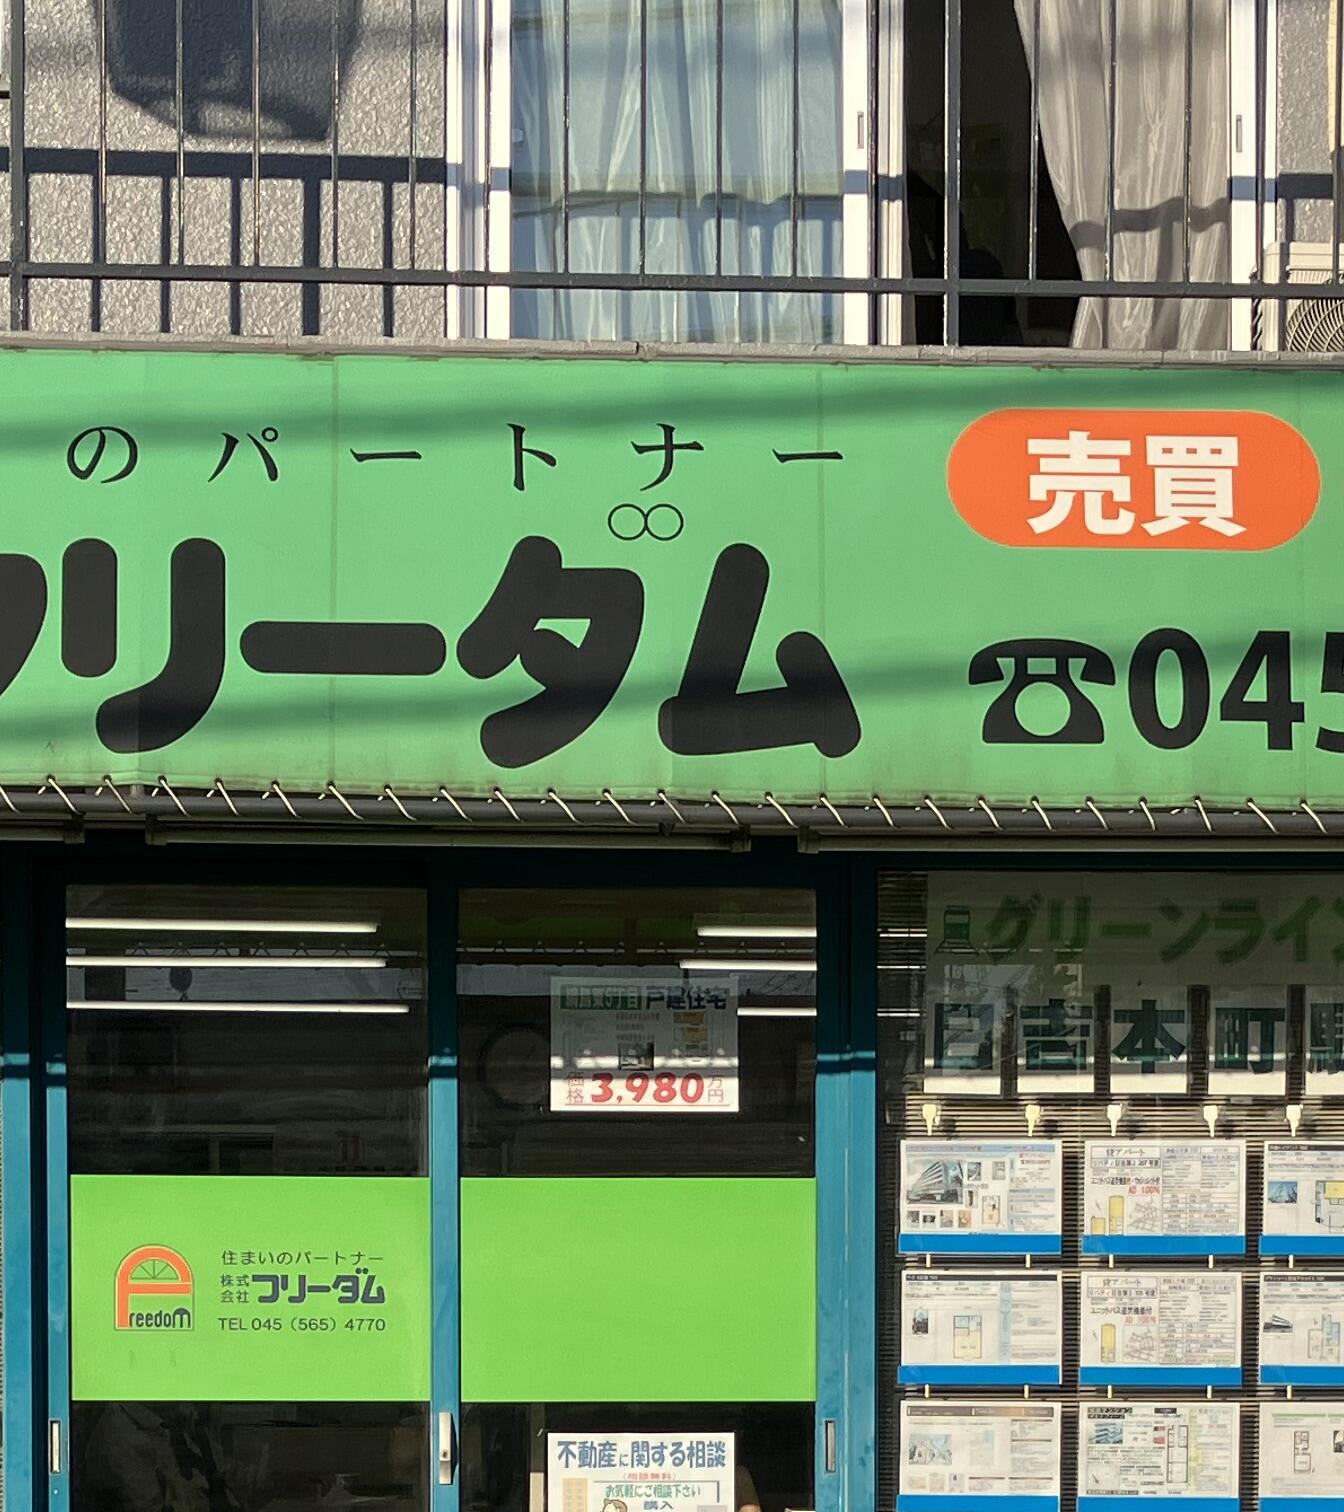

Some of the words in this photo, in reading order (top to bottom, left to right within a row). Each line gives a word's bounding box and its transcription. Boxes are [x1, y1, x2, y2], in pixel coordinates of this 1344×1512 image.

[1027, 431, 1247, 540] 売買
[591, 1071, 705, 1104] 3,980
[221, 1250, 384, 1266] 住まいのパートナー
[251, 1267, 386, 1304] フリーダム
[558, 1440, 726, 1468] 不動産に関する相談
[604, 1483, 701, 1498] お気軽にご相談下さい
